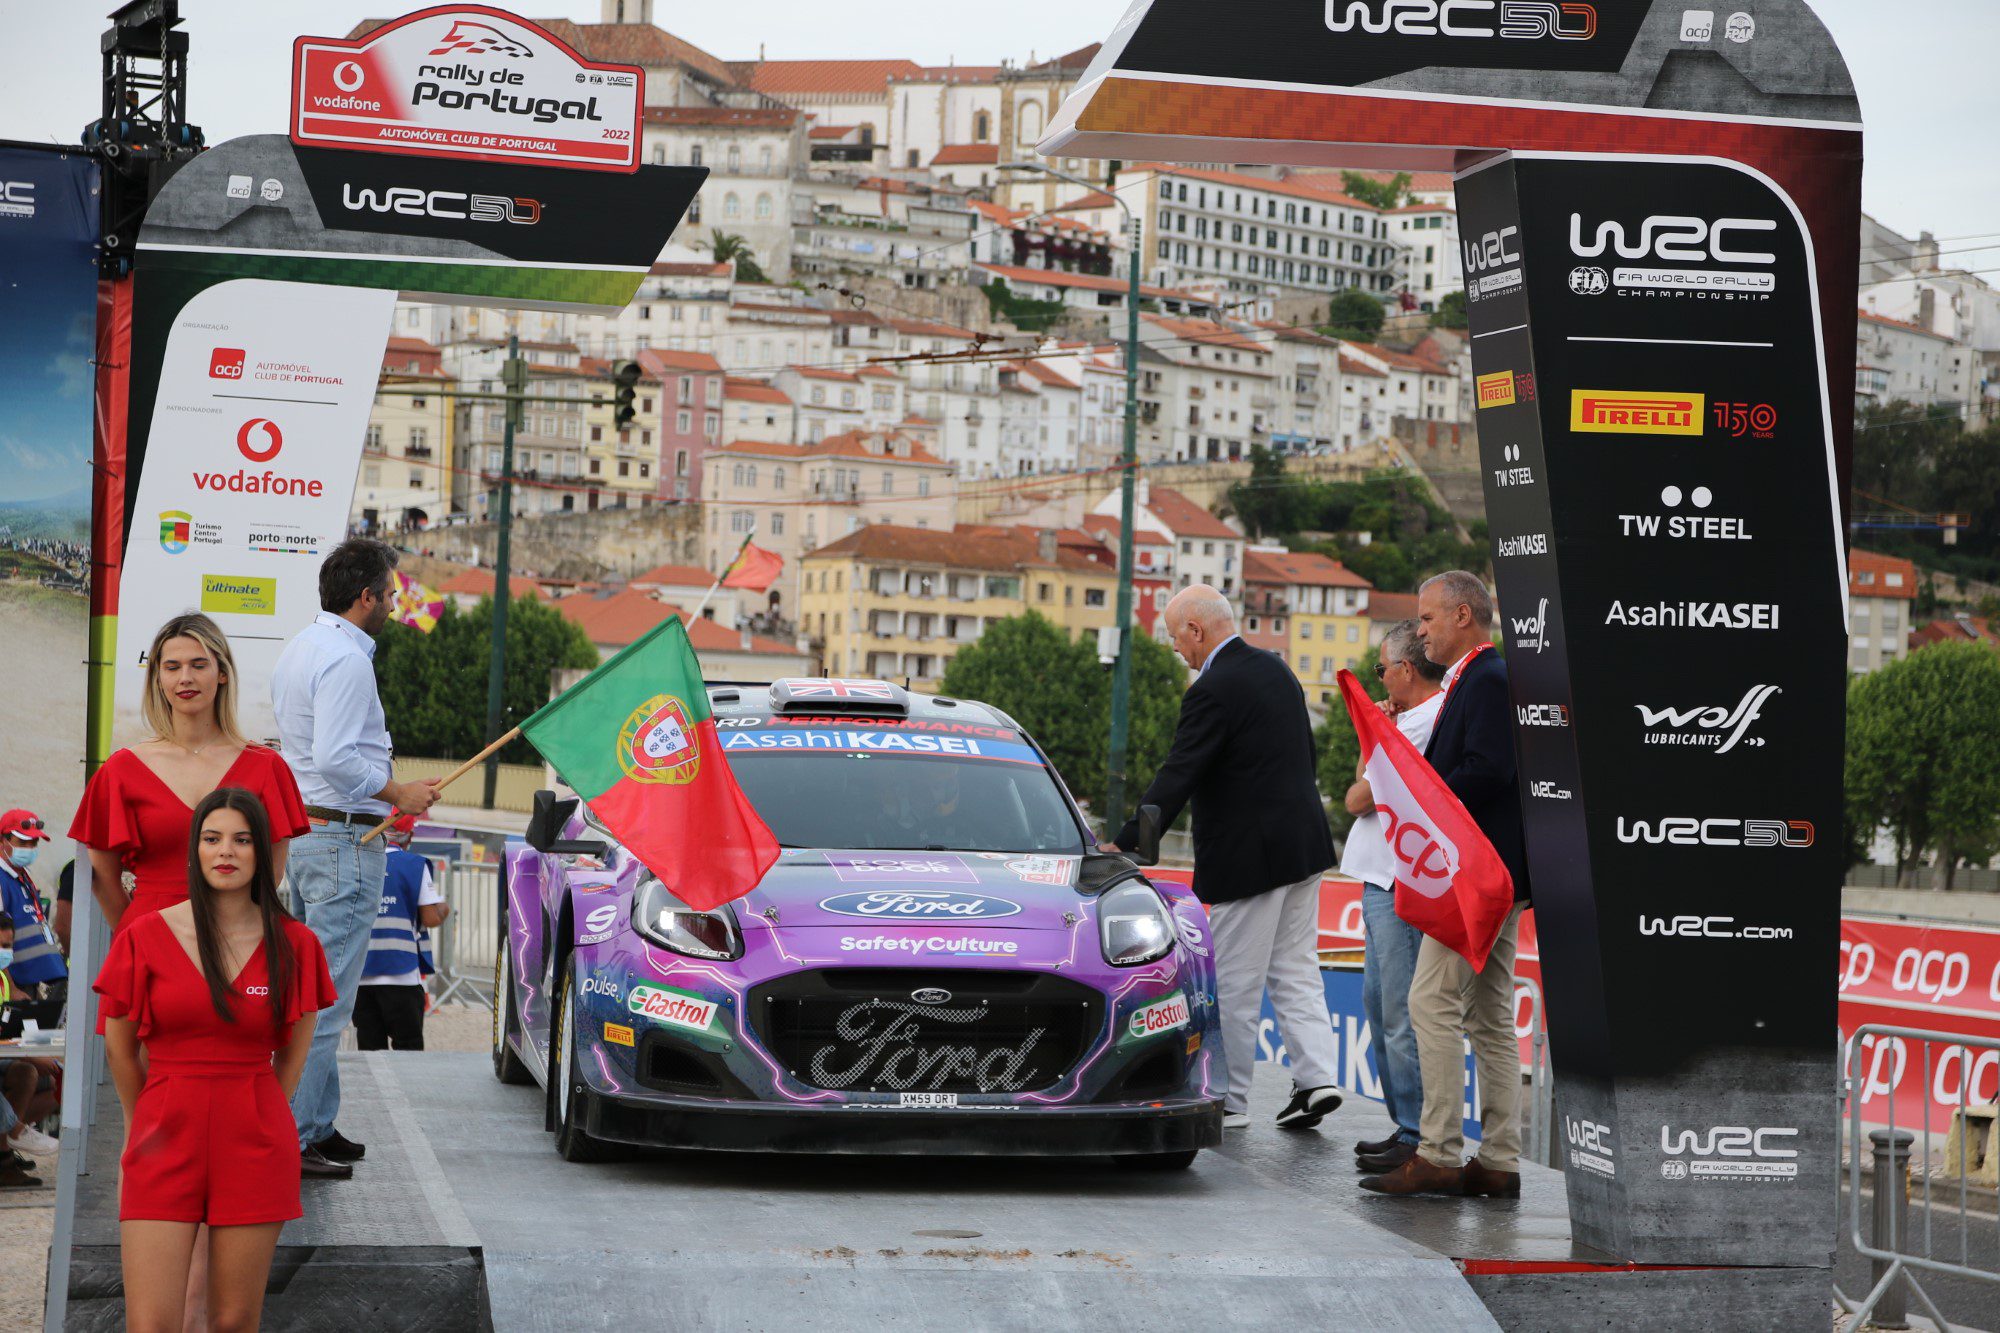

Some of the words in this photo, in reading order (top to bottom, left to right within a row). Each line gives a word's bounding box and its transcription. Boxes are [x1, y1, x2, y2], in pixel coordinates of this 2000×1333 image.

[1685, 27, 1710, 39] acp
[418, 63, 485, 87] rally
[489, 67, 525, 86] de
[313, 95, 381, 112] vodafone
[411, 81, 603, 124] Portugal
[378, 127, 449, 143] AUTOMÓVEL
[450, 133, 480, 145] CLUB
[481, 136, 498, 147] DE
[498, 138, 558, 152] PORTUGAL
[601, 128, 631, 141] 2022
[231, 187, 250, 197] acp
[1569, 212, 1778, 265] WRC
[1463, 225, 1520, 274] WRC
[1570, 267, 1609, 294] FIA
[1617, 272, 1643, 283] FIA
[1647, 274, 1708, 285] WORLD
[1712, 276, 1771, 287] RALLY
[1617, 288, 1770, 301] CHAMPIONSHIP
[214, 363, 243, 378] acp
[256, 361, 312, 374] AUTOMÓVEL
[254, 371, 278, 382] CLUB
[279, 373, 292, 382] DE
[293, 374, 345, 386] PORTUGAL
[1480, 377, 1512, 402] PIRELLI
[1581, 398, 1694, 427] PIRELLI
[1713, 402, 1777, 437] 150
[1751, 431, 1774, 439] YEARS
[192, 469, 324, 498] vodafone
[1494, 470, 1509, 488] TW
[1508, 466, 1535, 486] STEEL
[194, 529, 217, 538] Centro
[195, 522, 222, 532] Turismo
[1618, 514, 1662, 538] TW
[1668, 516, 1753, 540] STEEL
[193, 536, 223, 545] Portugal
[205, 582, 261, 595] ultimate
[713, 716, 763, 729] RD
[766, 714, 1016, 741] PERFORMANCE
[1643, 732, 1722, 746] LUBRICANTS
[1530, 780, 1573, 800] WRC.com
[854, 864, 953, 874] DOOR
[856, 892, 986, 916] Ford
[1639, 914, 1794, 940] WRC.com
[840, 935, 1019, 956] SafetyCulture
[1891, 946, 1971, 1004] acp
[245, 986, 269, 997] acp
[918, 990, 945, 1003] Ford
[644, 992, 711, 1027] Castrol
[1145, 998, 1190, 1032] Castrol
[606, 1025, 632, 1044] PIRELLI
[810, 1000, 1048, 1092] Ford
[902, 1093, 932, 1104] XM59
[934, 1094, 958, 1104] ORT
[1566, 1114, 1613, 1157] WRC
[1661, 1124, 1799, 1158] WRC
[1692, 1174, 1795, 1183] CHAMPIONSHIP
[1712, 1165, 1752, 1173] WORLD
[1756, 1165, 1795, 1173] RALLY
